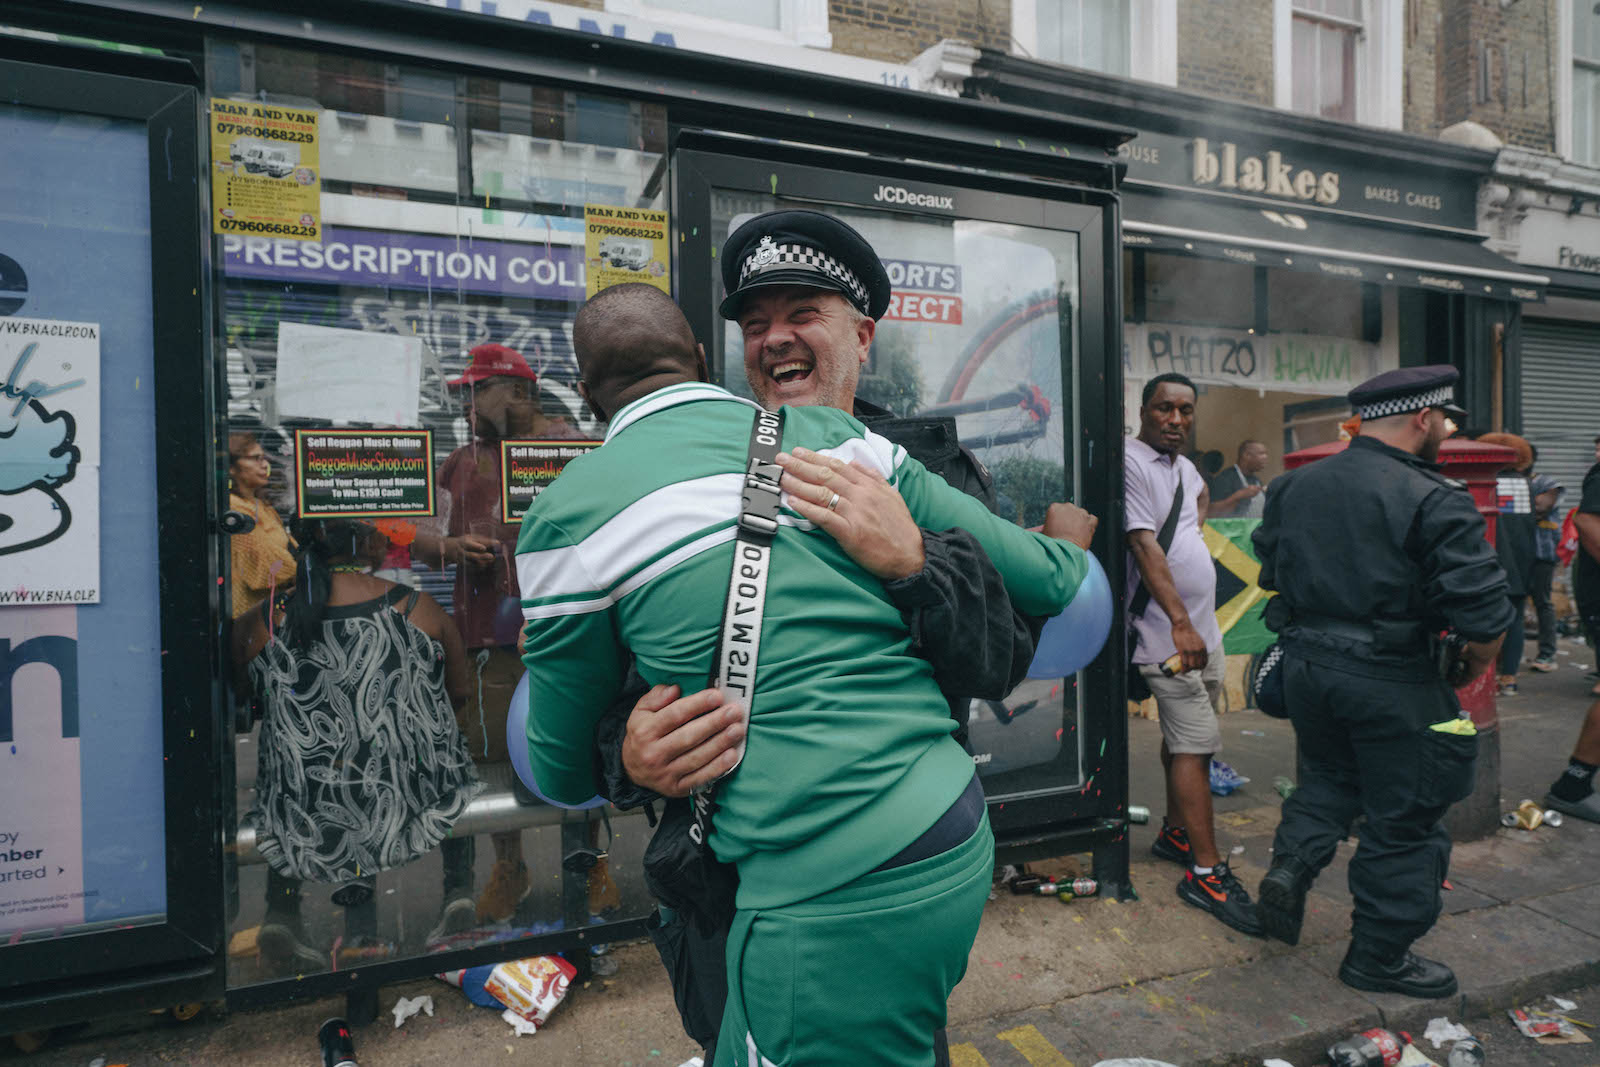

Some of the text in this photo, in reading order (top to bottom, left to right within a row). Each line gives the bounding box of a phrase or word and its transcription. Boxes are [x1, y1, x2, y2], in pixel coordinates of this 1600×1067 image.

[880, 71, 910, 88] 114
[213, 103, 316, 124] MAN AND VAN
[217, 122, 314, 143] 07960668229
[1192, 137, 1341, 205] blakes
[873, 185, 954, 210] JCDecaux
[1365, 185, 1442, 211] BAKES CAKES
[586, 207, 665, 222] MAN AND VAN
[220, 219, 317, 237] 07960668229
[589, 224, 664, 240] 07960668229
[224, 234, 498, 281] PRESCRIPTION
[884, 262, 955, 290] ORTS
[885, 295, 956, 321] RECT
[307, 437, 421, 449] Sell Reggae Music Online
[510, 447, 527, 457] Sell
[528, 447, 559, 458] Reggae
[560, 448, 584, 457] Music
[308, 451, 425, 477] ReggaeMusicShop.com
[306, 478, 334, 488] Upload
[336, 478, 353, 487] Your
[354, 478, 378, 488] Songs
[379, 478, 394, 486] and
[509, 486, 535, 495] Upload
[332, 488, 404, 498] To Win £150 Cash!
